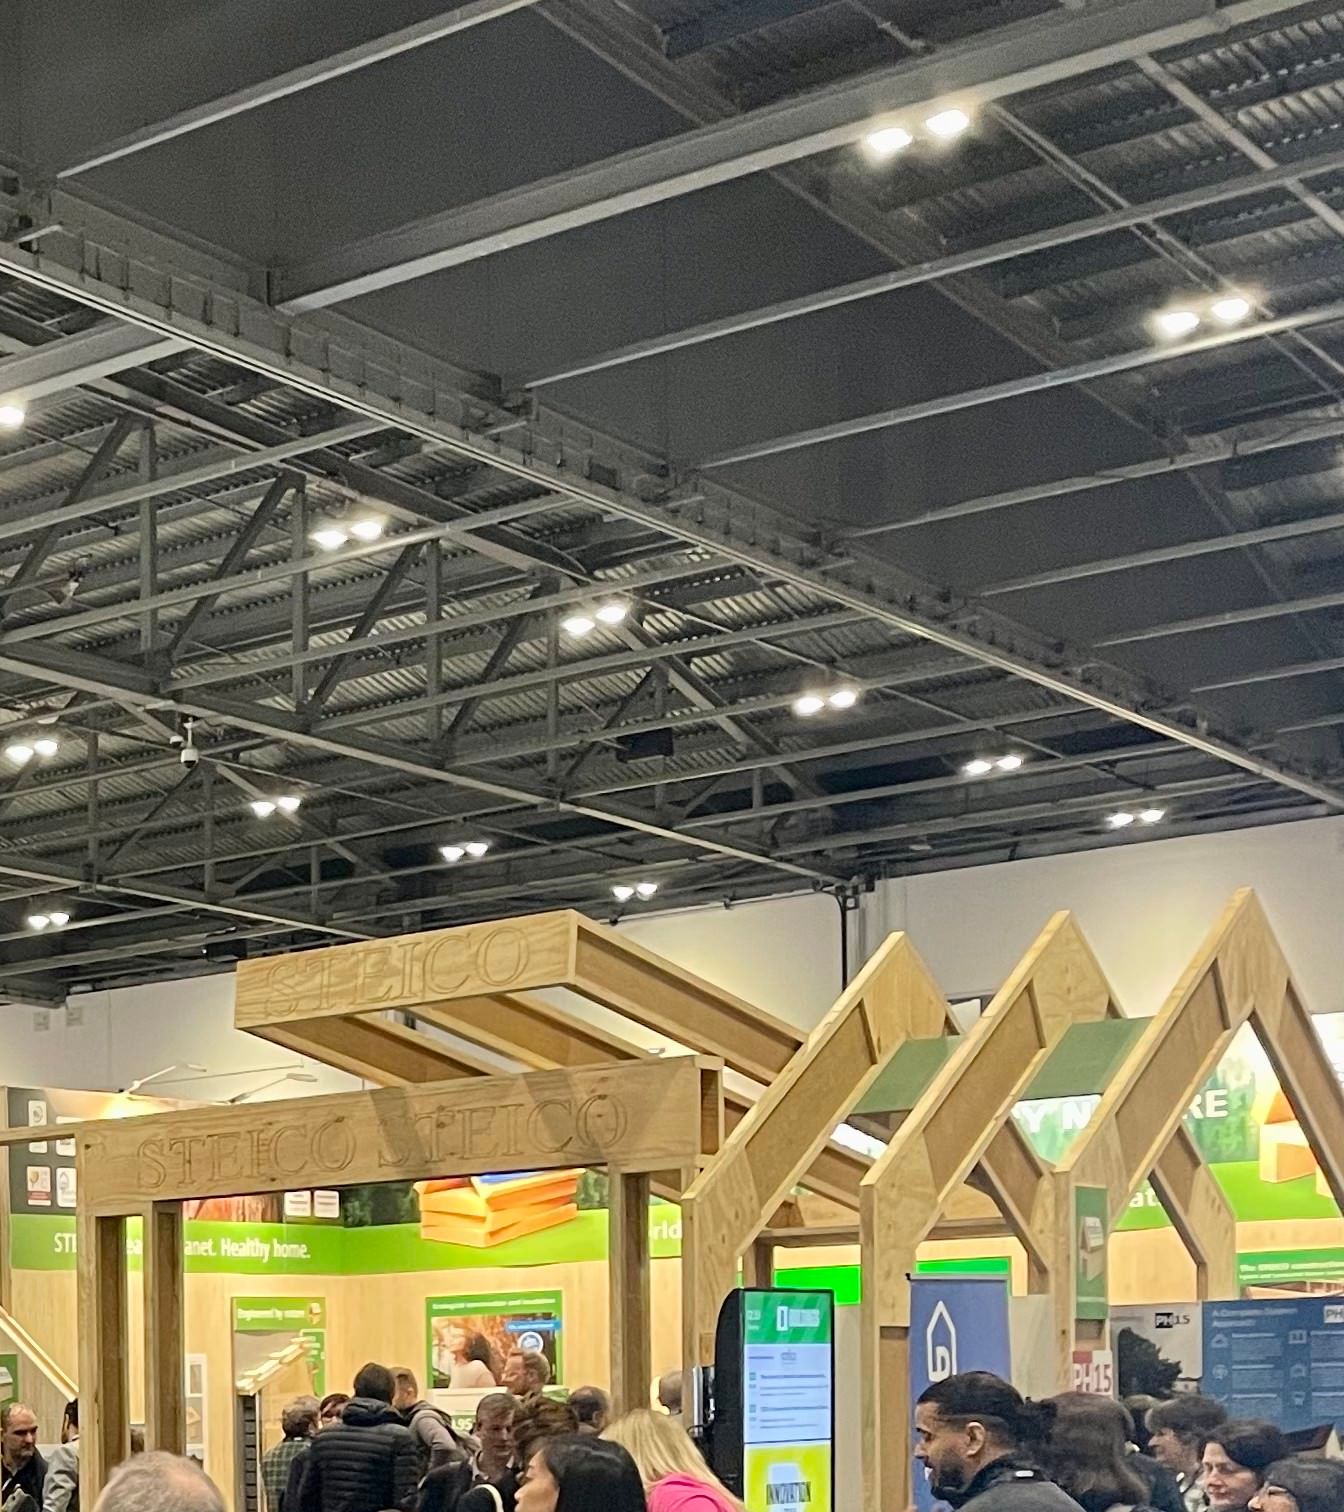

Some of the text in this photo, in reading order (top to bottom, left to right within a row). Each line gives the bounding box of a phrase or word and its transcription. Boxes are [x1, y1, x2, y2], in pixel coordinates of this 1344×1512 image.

[264, 927, 530, 1018] STEICO
[137, 1094, 627, 1189] STEICO STEICO
[653, 1218, 682, 1240] rld
[185, 1237, 311, 1263] anet. Healthy home.
[1156, 1313, 1191, 1328] PH15
